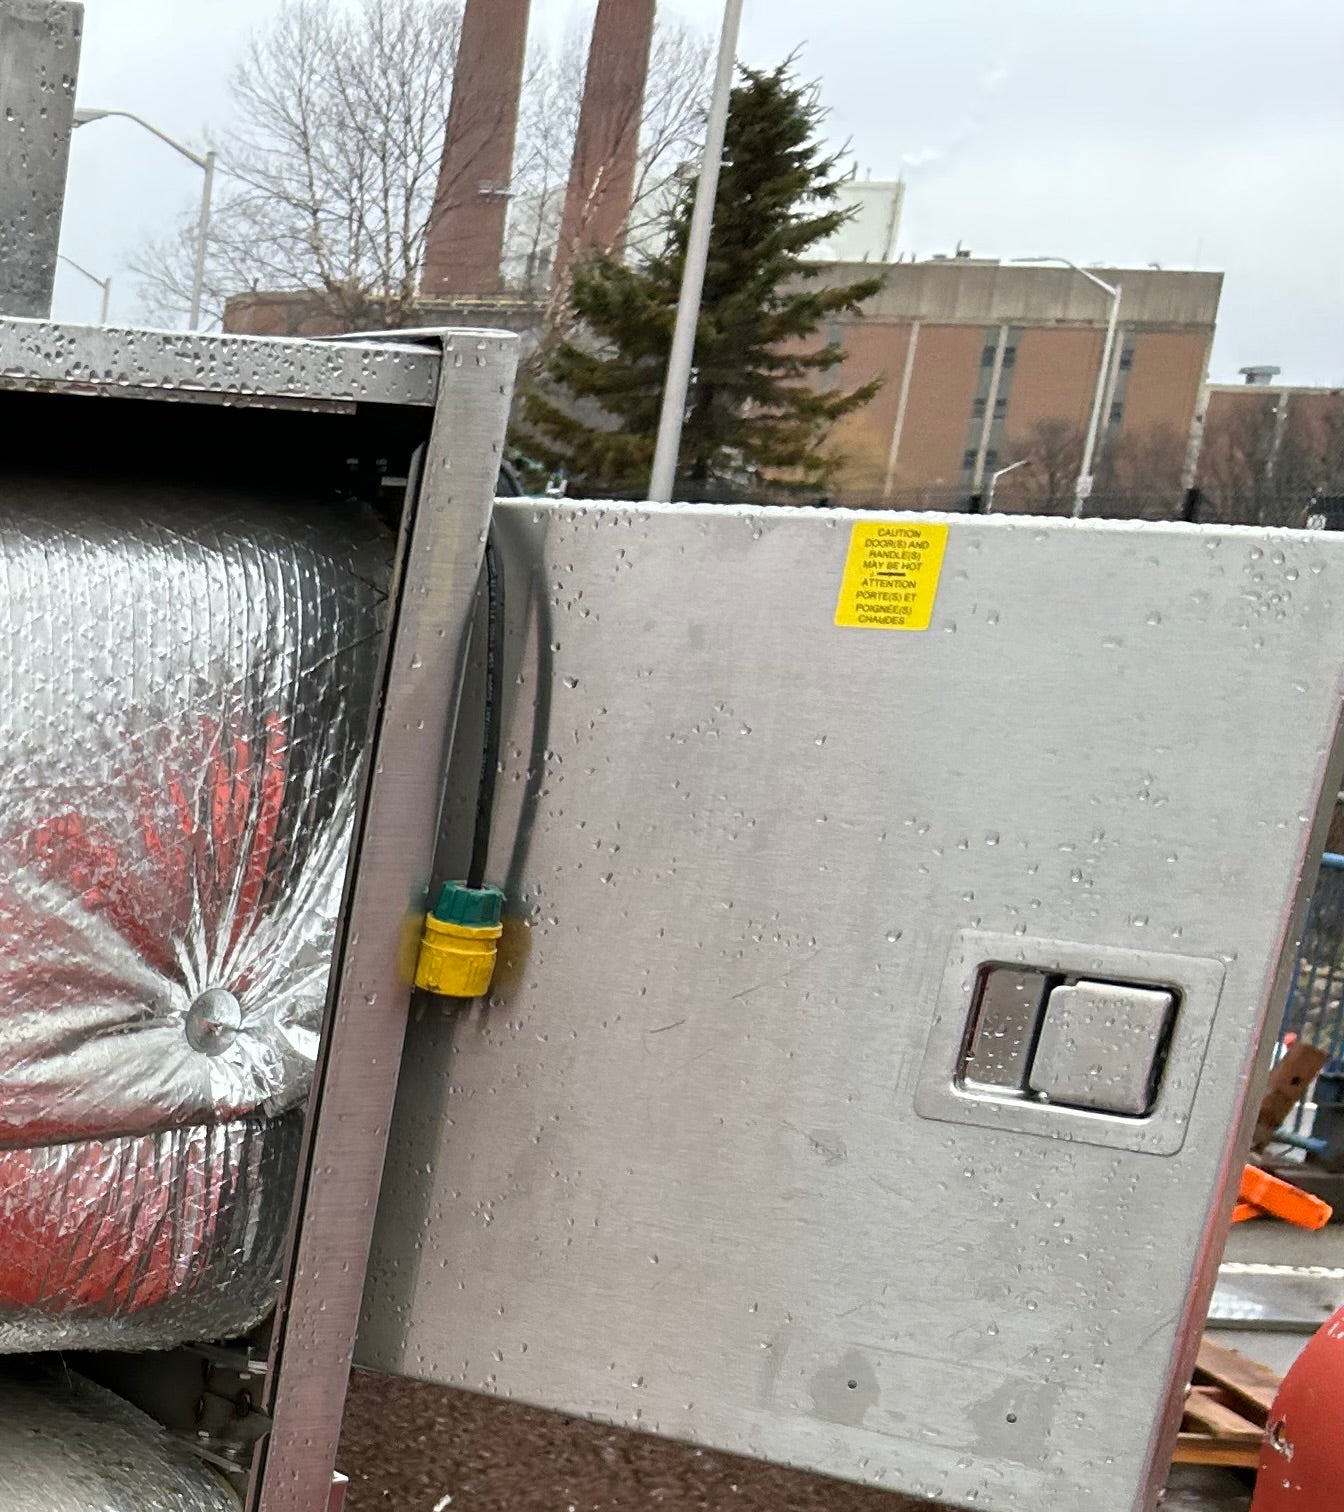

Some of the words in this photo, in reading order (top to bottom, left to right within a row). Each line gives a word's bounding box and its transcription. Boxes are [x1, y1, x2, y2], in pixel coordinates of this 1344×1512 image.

[878, 528, 921, 538] CAUTION
[864, 539, 907, 549] DOOR(S)
[908, 541, 930, 550] AND
[869, 550, 921, 560] HANDLE(S)
[863, 560, 883, 570] MAY
[886, 562, 899, 570] BE
[901, 562, 923, 571] HOT
[862, 578, 916, 588] ATTENTION
[856, 591, 902, 602] PORTE(S)
[904, 593, 916, 602] ET
[858, 614, 905, 625] CHAUDES
